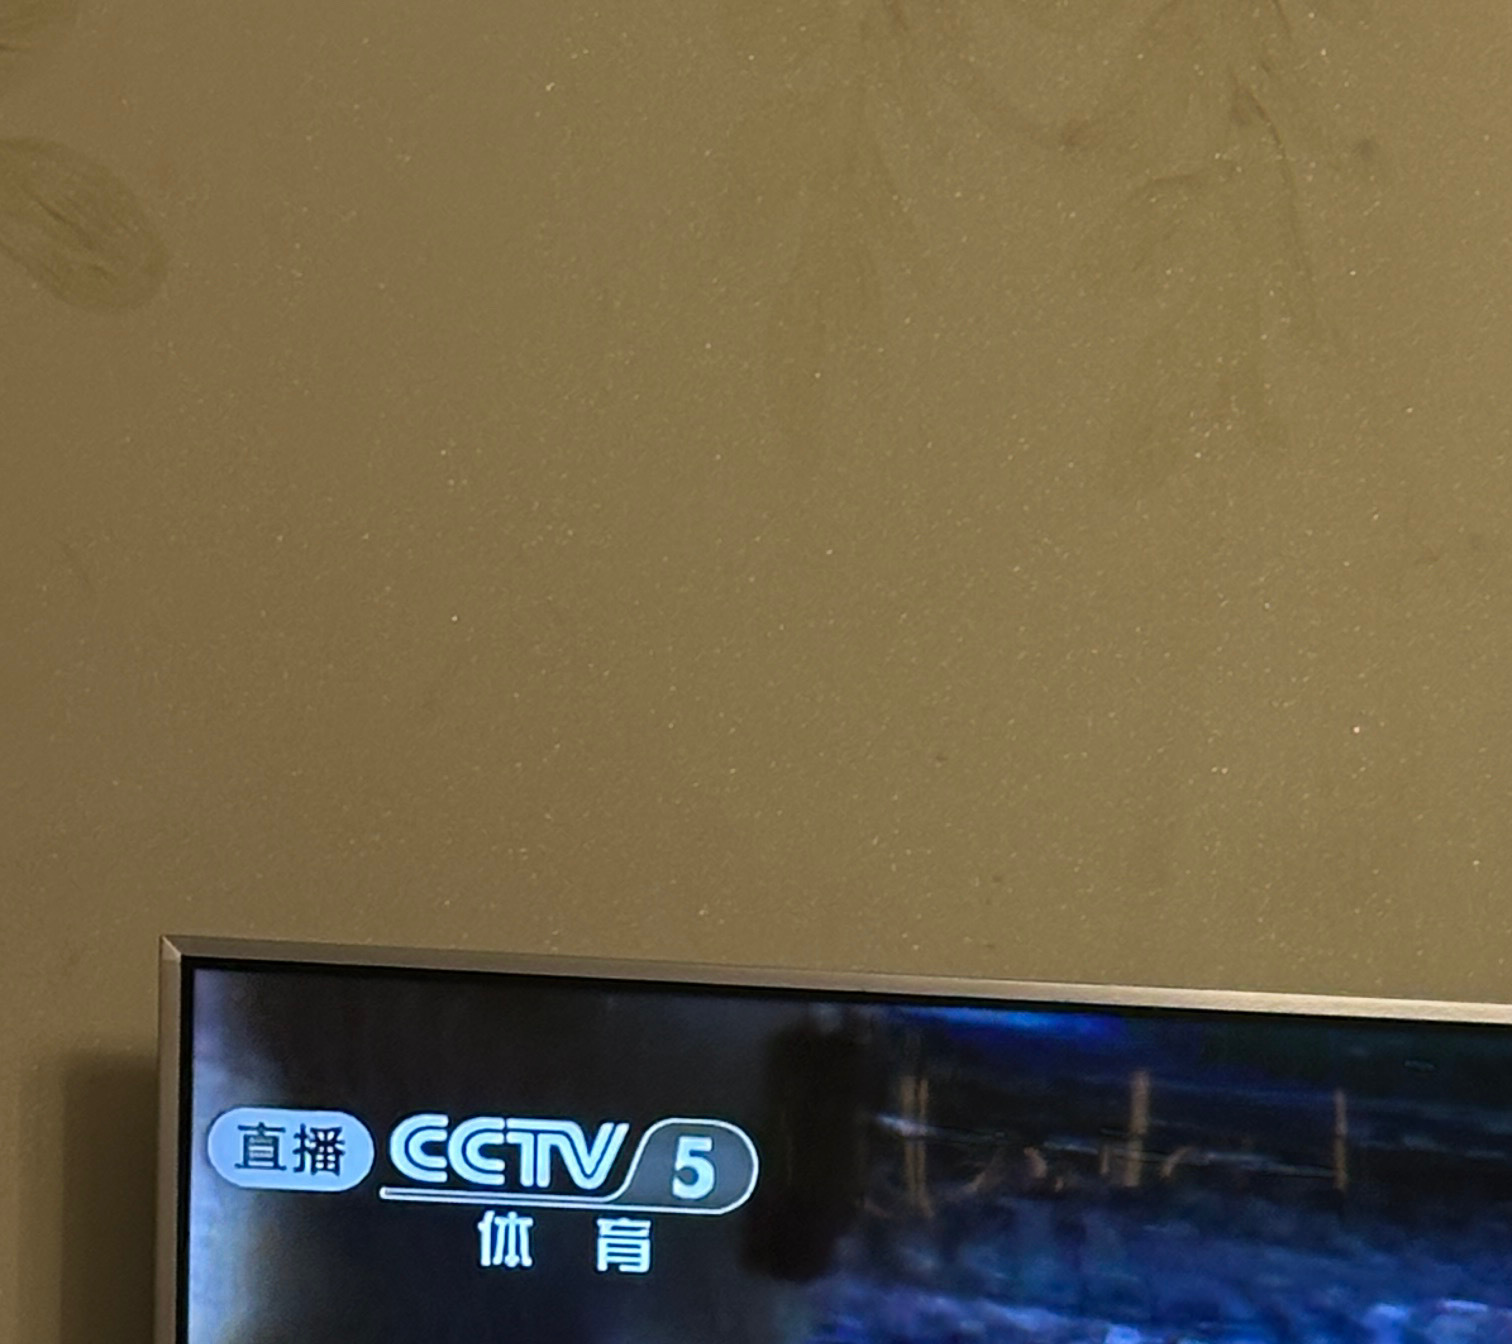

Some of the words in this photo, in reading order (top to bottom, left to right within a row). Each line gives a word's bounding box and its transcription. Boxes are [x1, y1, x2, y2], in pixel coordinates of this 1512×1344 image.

[234, 1122, 346, 1176] 直播
[389, 1114, 630, 1190] CCTV
[671, 1136, 716, 1199] 5
[477, 1210, 652, 1274] 体育
